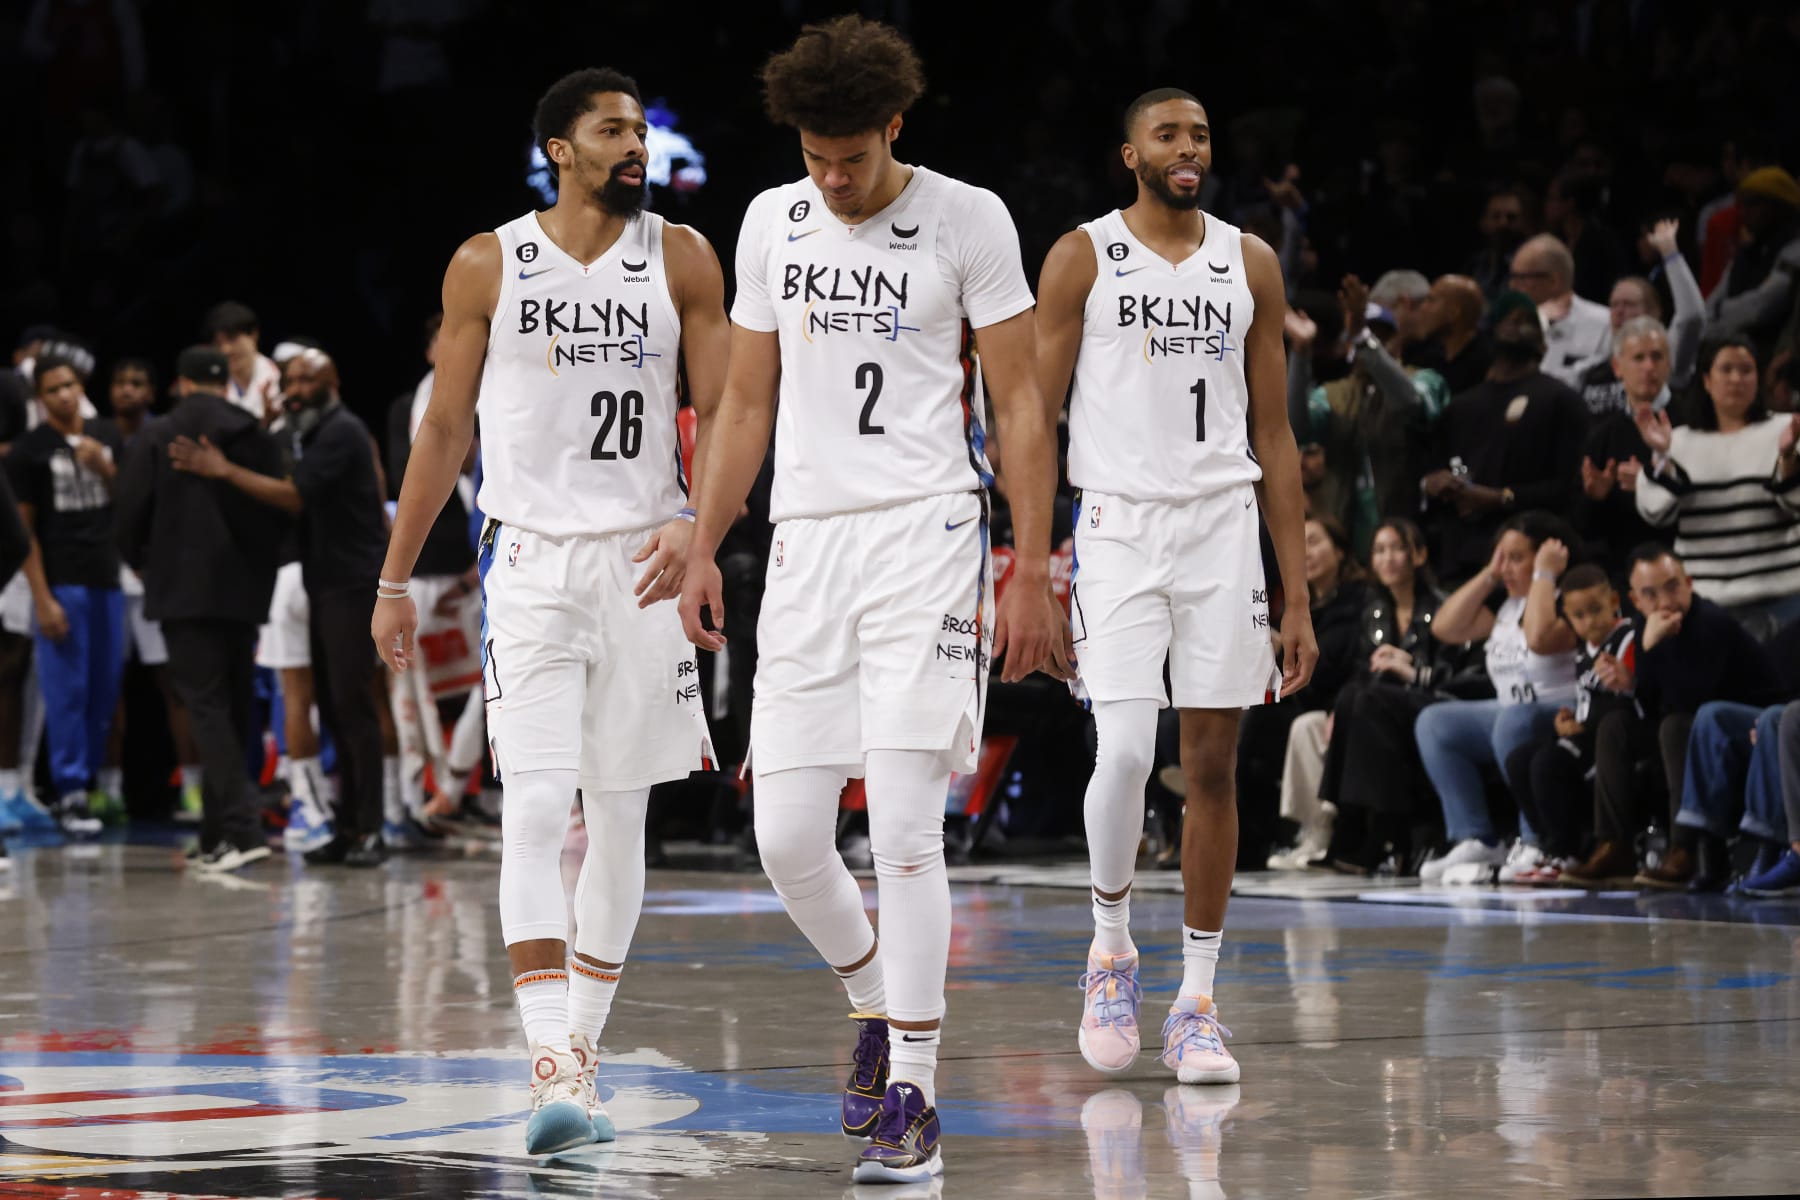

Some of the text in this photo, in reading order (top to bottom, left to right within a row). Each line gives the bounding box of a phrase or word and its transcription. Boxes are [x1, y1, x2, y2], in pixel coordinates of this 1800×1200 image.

[793, 203, 806, 219] 6
[521, 245, 534, 258] 6
[889, 241, 918, 251] Webull
[1112, 245, 1124, 259] 6
[623, 275, 650, 283] Webull
[782, 263, 908, 309] BKLYN
[1210, 276, 1232, 285] Webull
[518, 298, 648, 337] BKLYN
[1118, 294, 1231, 333] BKLYN
[855, 362, 885, 435] 2
[1190, 378, 1205, 442] 1
[590, 389, 644, 461] 26
